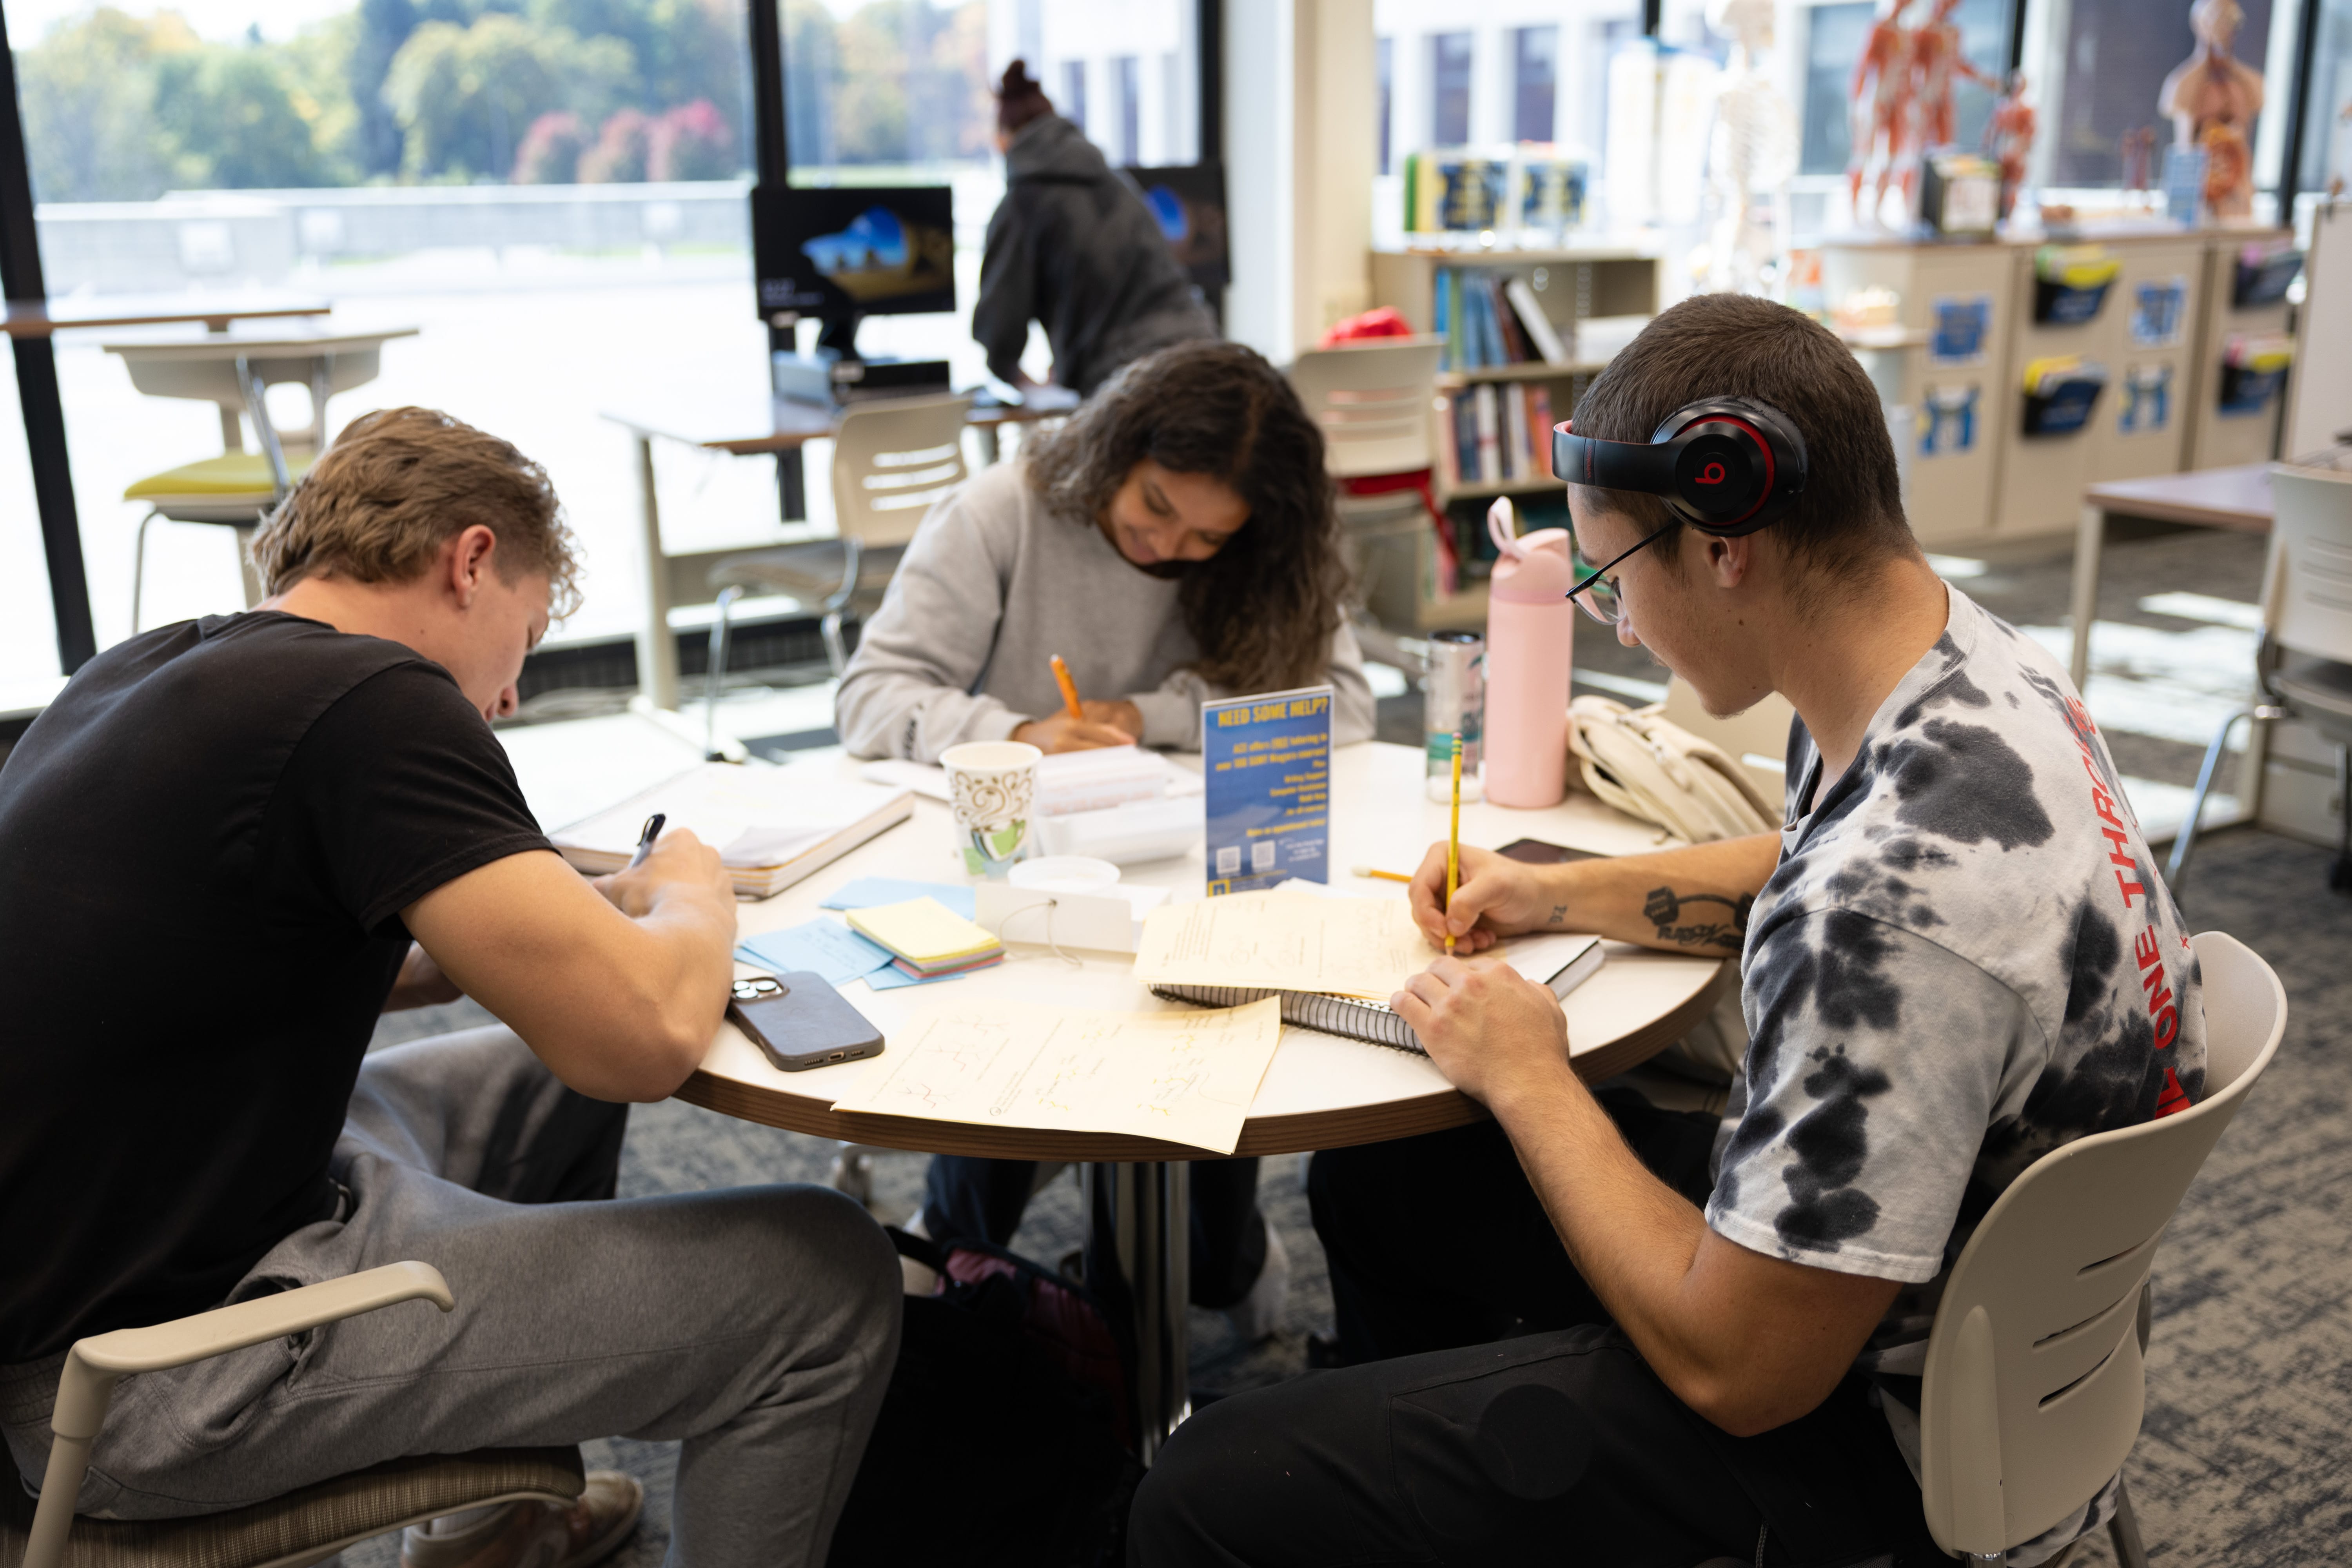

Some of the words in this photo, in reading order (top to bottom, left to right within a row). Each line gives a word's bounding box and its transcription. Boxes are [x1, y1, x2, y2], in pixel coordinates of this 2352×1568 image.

[1218, 708, 1250, 728] NEED
[1253, 702, 1287, 722] SOME
[1290, 697, 1328, 717] HELP?
[2135, 925, 2177, 1049] ONE
